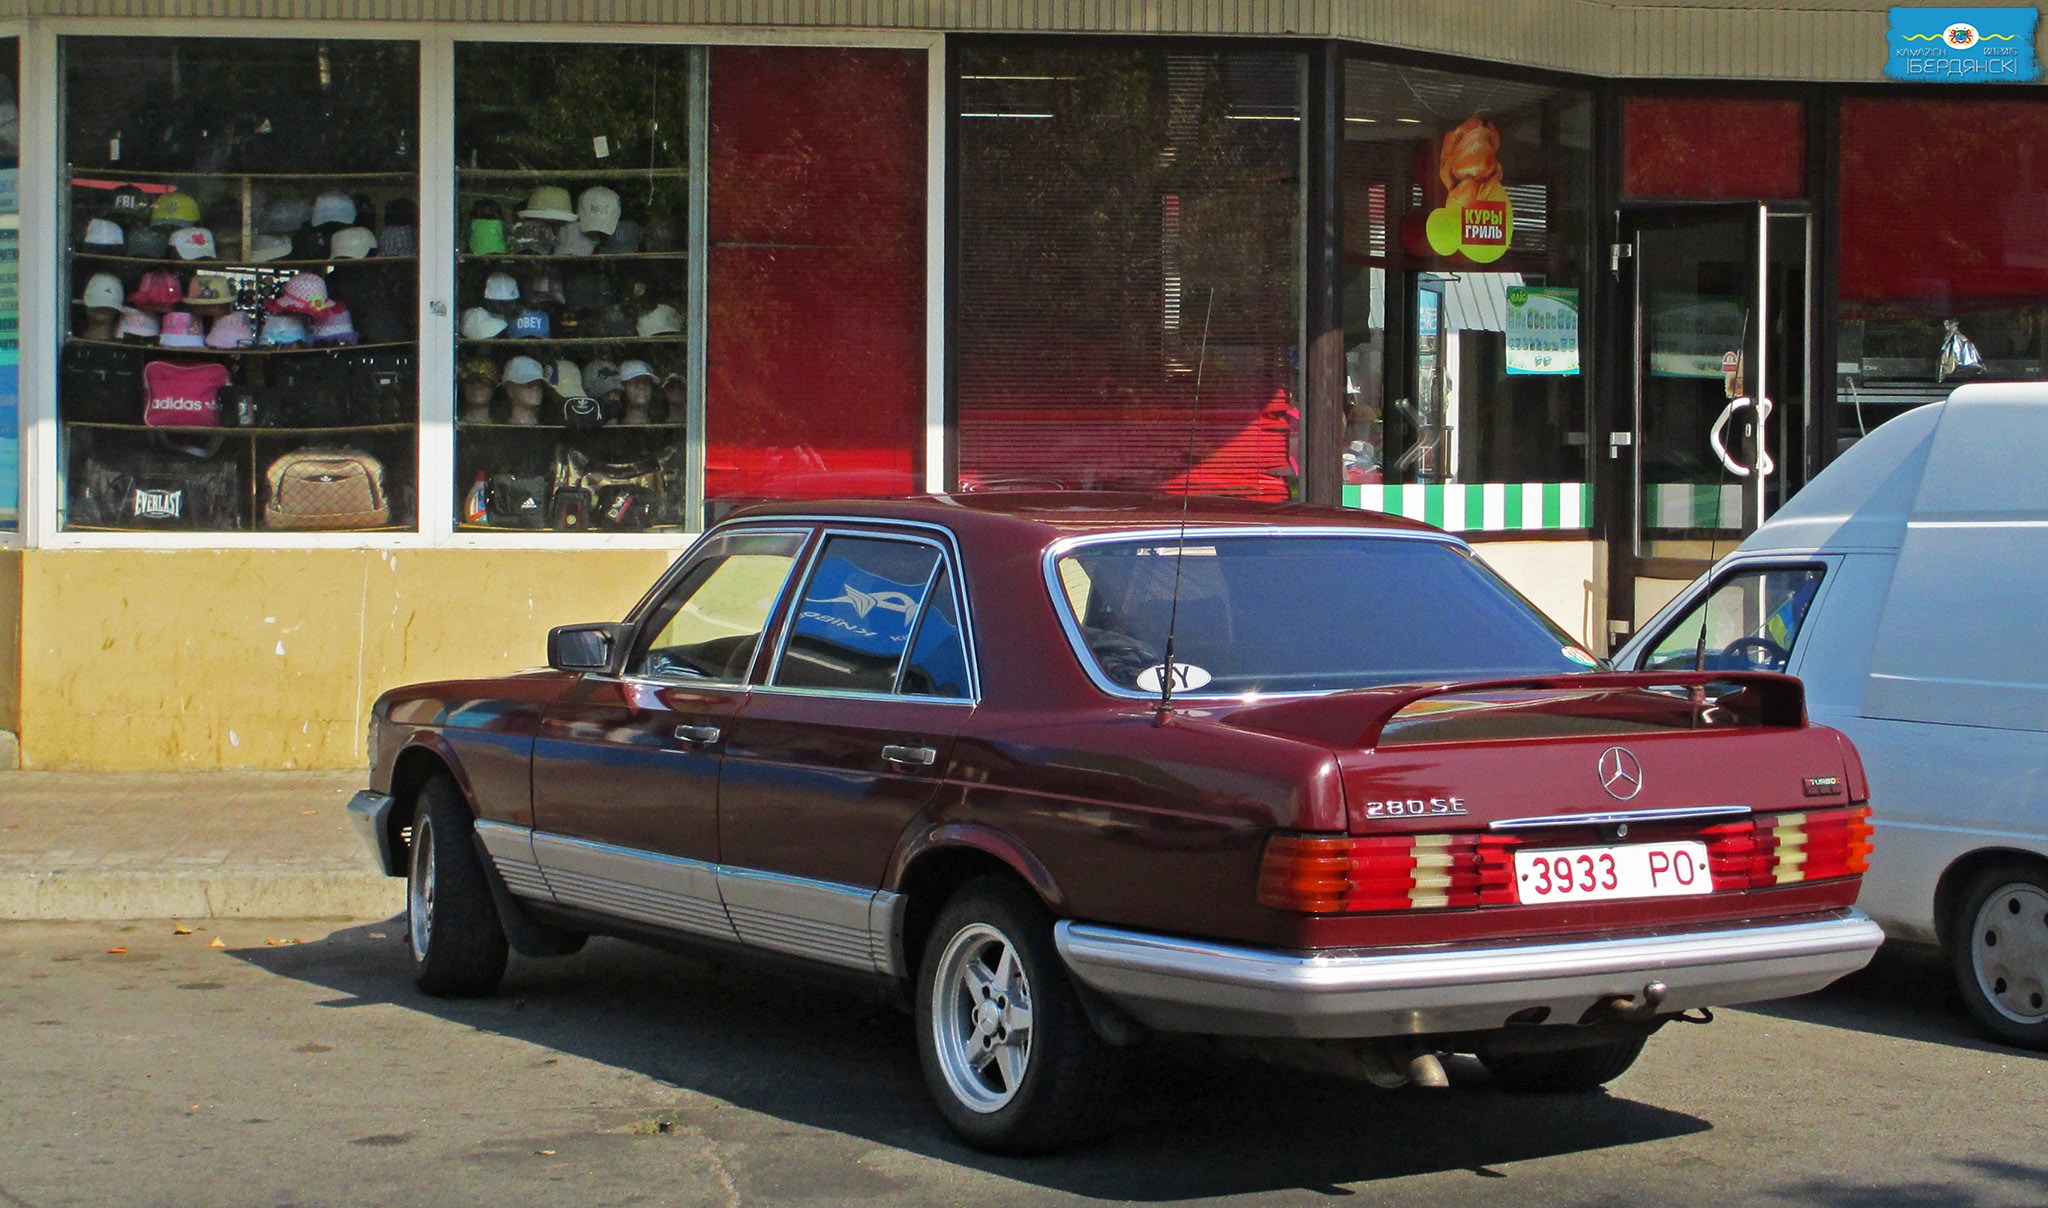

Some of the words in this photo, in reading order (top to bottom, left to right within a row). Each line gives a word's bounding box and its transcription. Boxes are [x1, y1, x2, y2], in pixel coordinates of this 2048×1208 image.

[115, 194, 134, 209] FBI
[1465, 209, 1503, 225] КУРЫ
[1465, 225, 1503, 239] ГРИЛЬ
[517, 316, 542, 329] OBEY
[152, 397, 202, 411] adidas
[134, 489, 182, 517] EVERLAST
[1806, 777, 1837, 786] TURBO
[1367, 800, 1424, 815] 280
[1430, 798, 1467, 813] SE
[1532, 853, 1618, 895] 3933
[1648, 849, 1695, 888] PO
